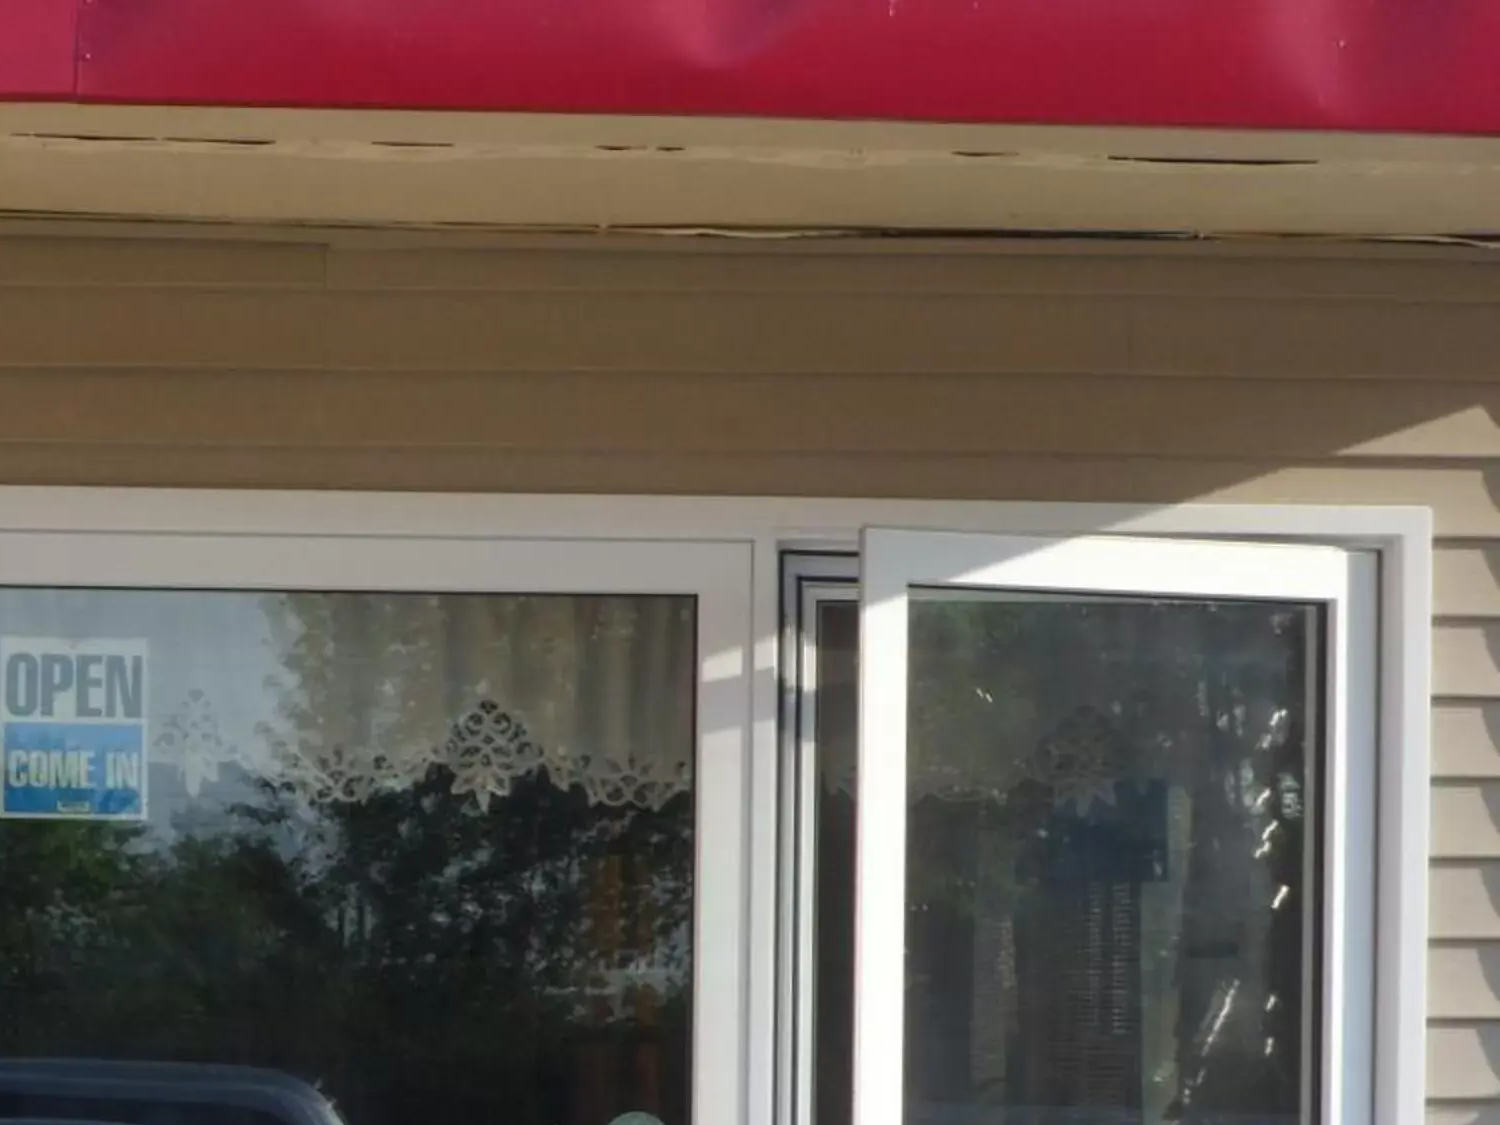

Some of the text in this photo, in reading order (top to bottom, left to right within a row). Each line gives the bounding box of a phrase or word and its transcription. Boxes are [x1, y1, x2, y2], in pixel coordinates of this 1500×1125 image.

[5, 652, 143, 718] OPEN
[8, 749, 140, 791] COME IN
